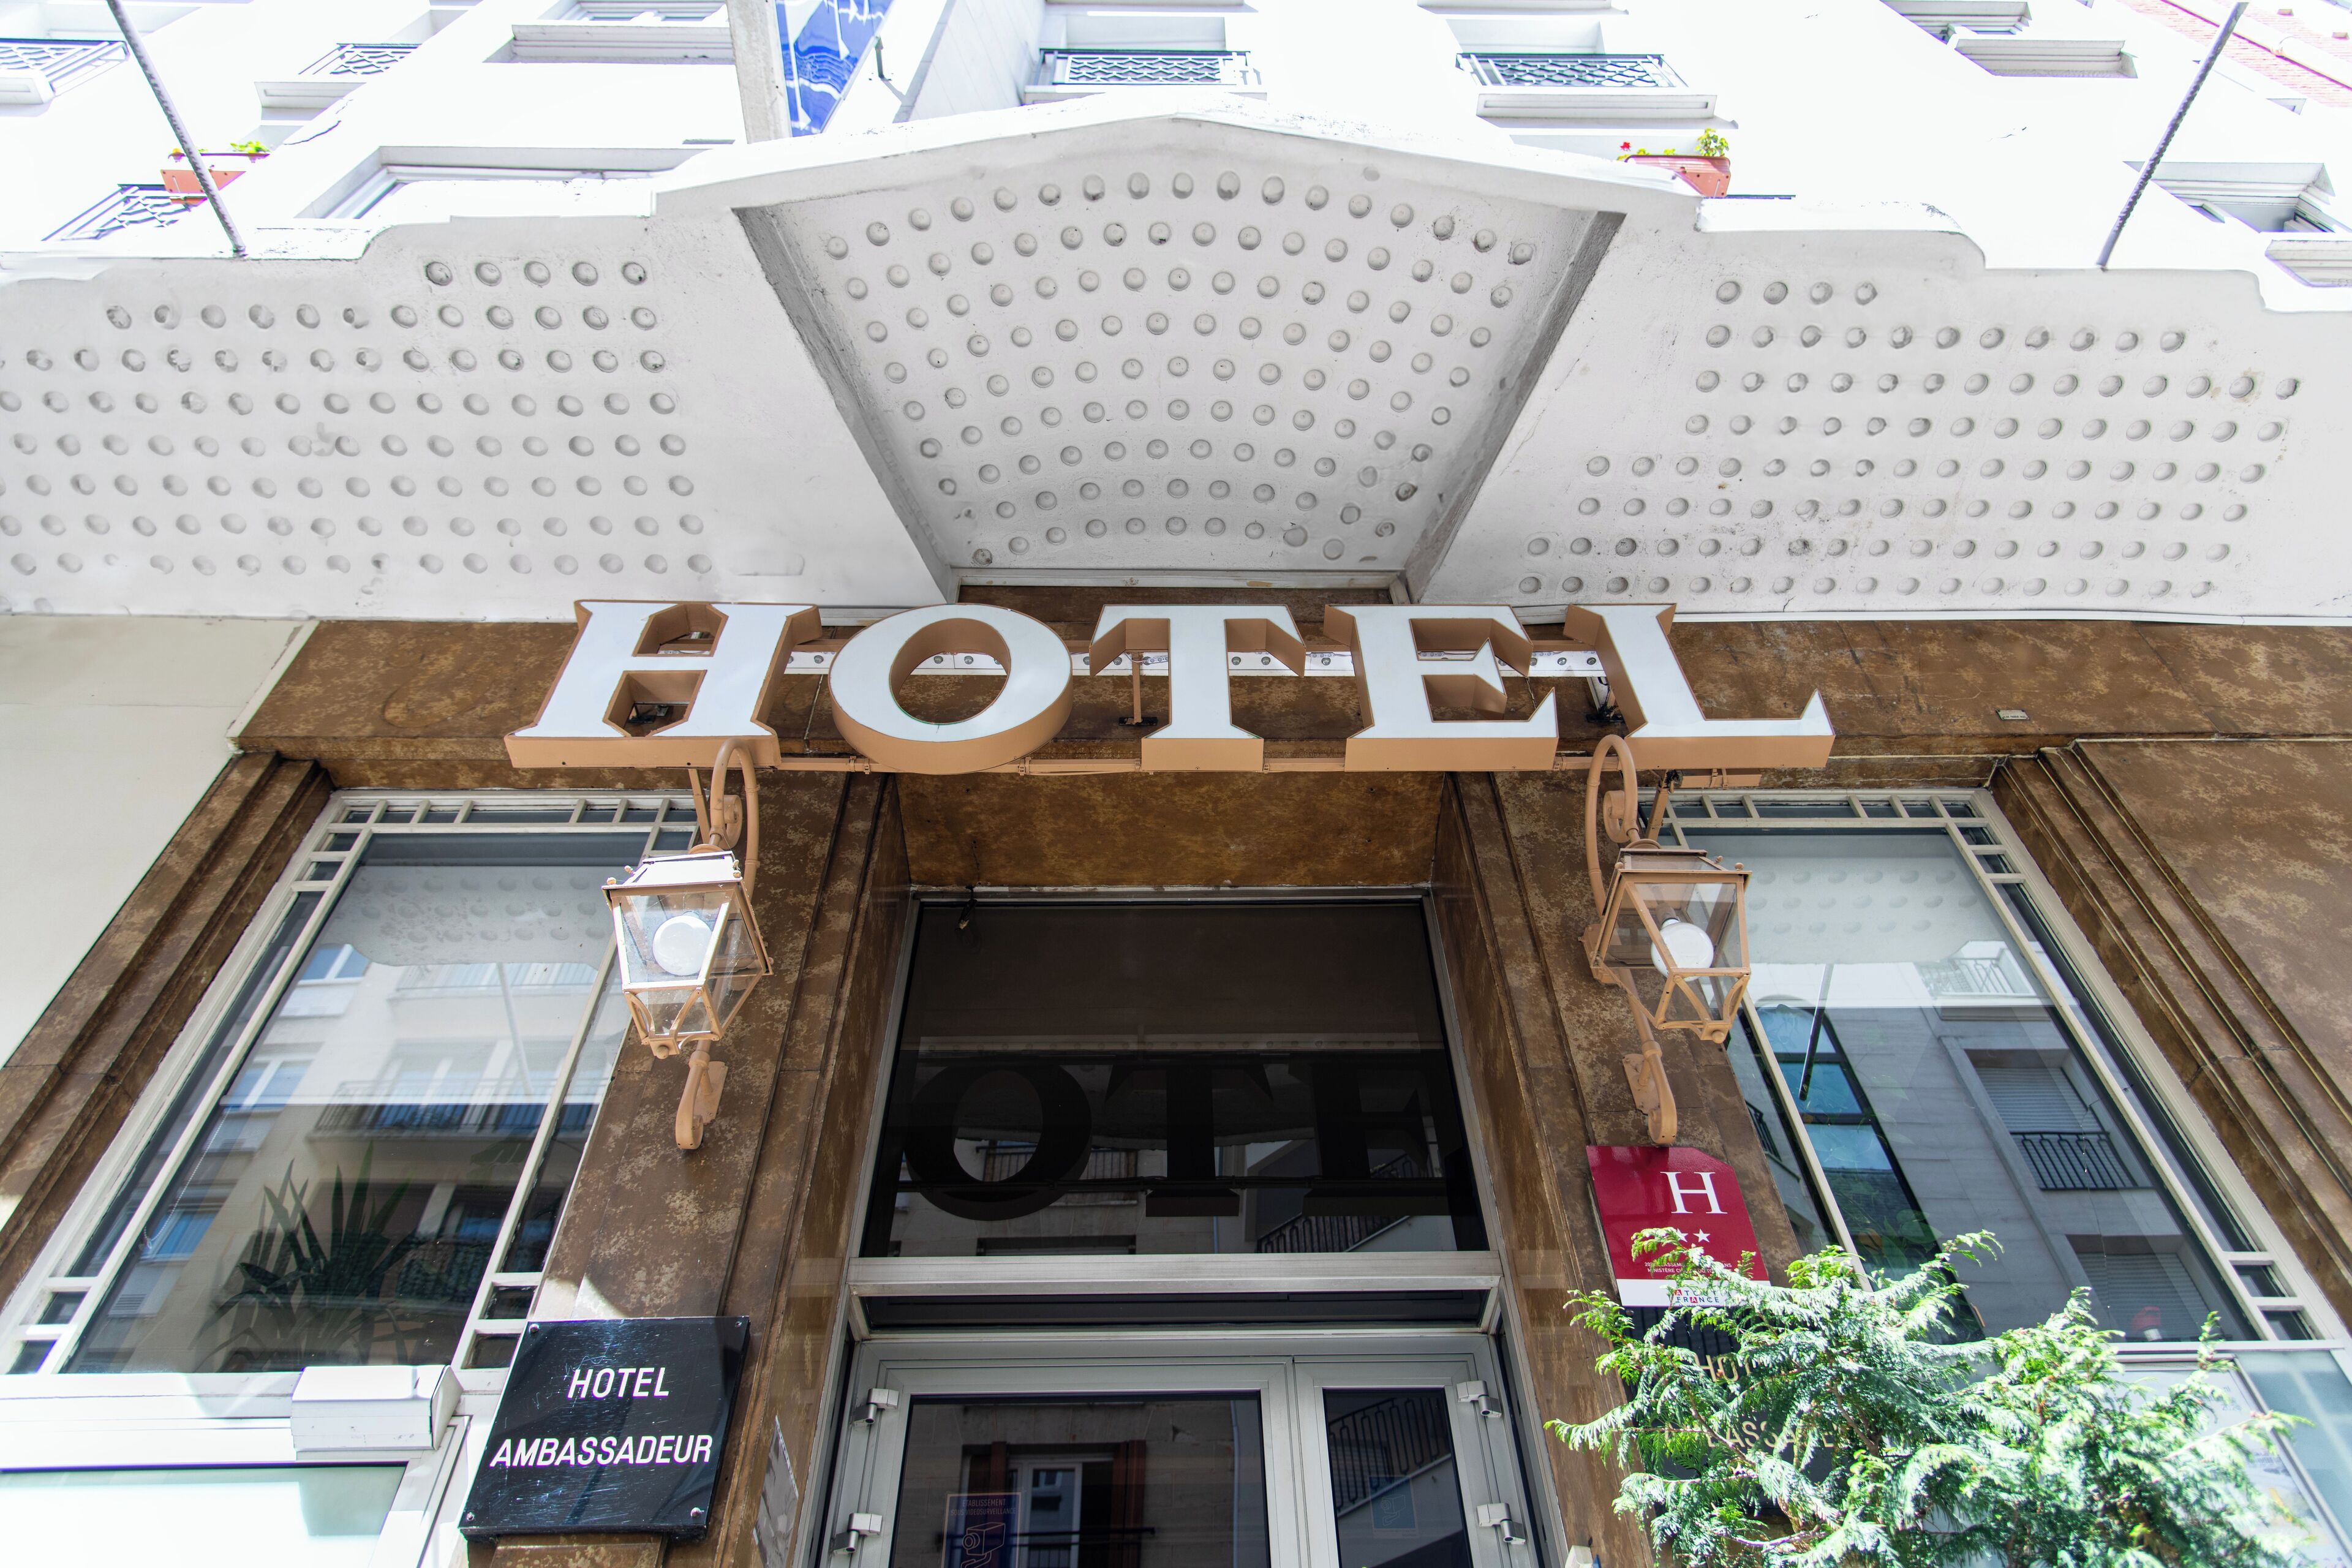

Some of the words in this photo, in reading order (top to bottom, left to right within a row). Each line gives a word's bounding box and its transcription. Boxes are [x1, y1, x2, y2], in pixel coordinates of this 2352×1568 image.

[505, 600, 1836, 771] HOTEL
[1660, 1172, 1727, 1214] H
[567, 1367, 669, 1398] HOTEL
[489, 1434, 713, 1467] AMBASSADEUR
